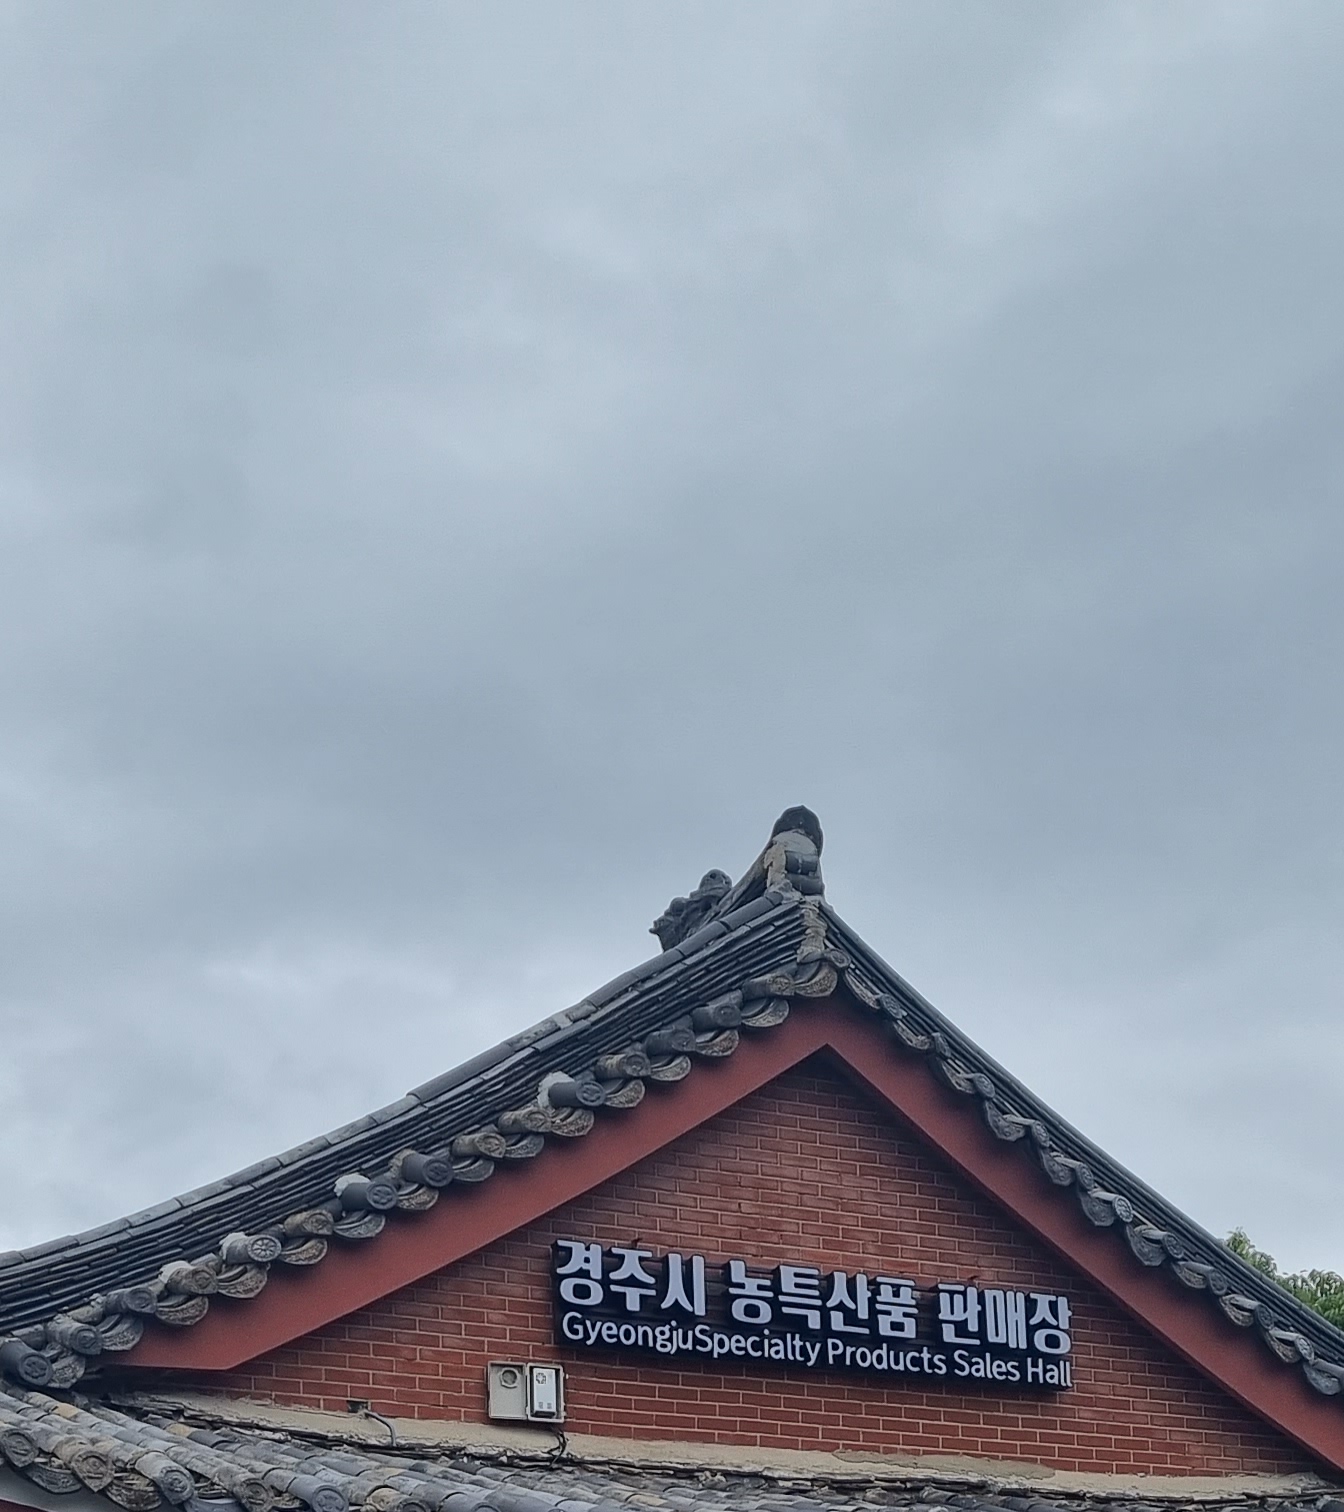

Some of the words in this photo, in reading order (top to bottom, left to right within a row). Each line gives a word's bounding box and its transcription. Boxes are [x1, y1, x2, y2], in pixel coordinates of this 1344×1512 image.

[556, 1239, 706, 1317] 경주시
[728, 1259, 919, 1339] 농특산품
[937, 1283, 1073, 1355] 판매장
[826, 1337, 947, 1375] Products
[953, 1349, 1021, 1382] Sales
[1027, 1357, 1074, 1388] Hall
